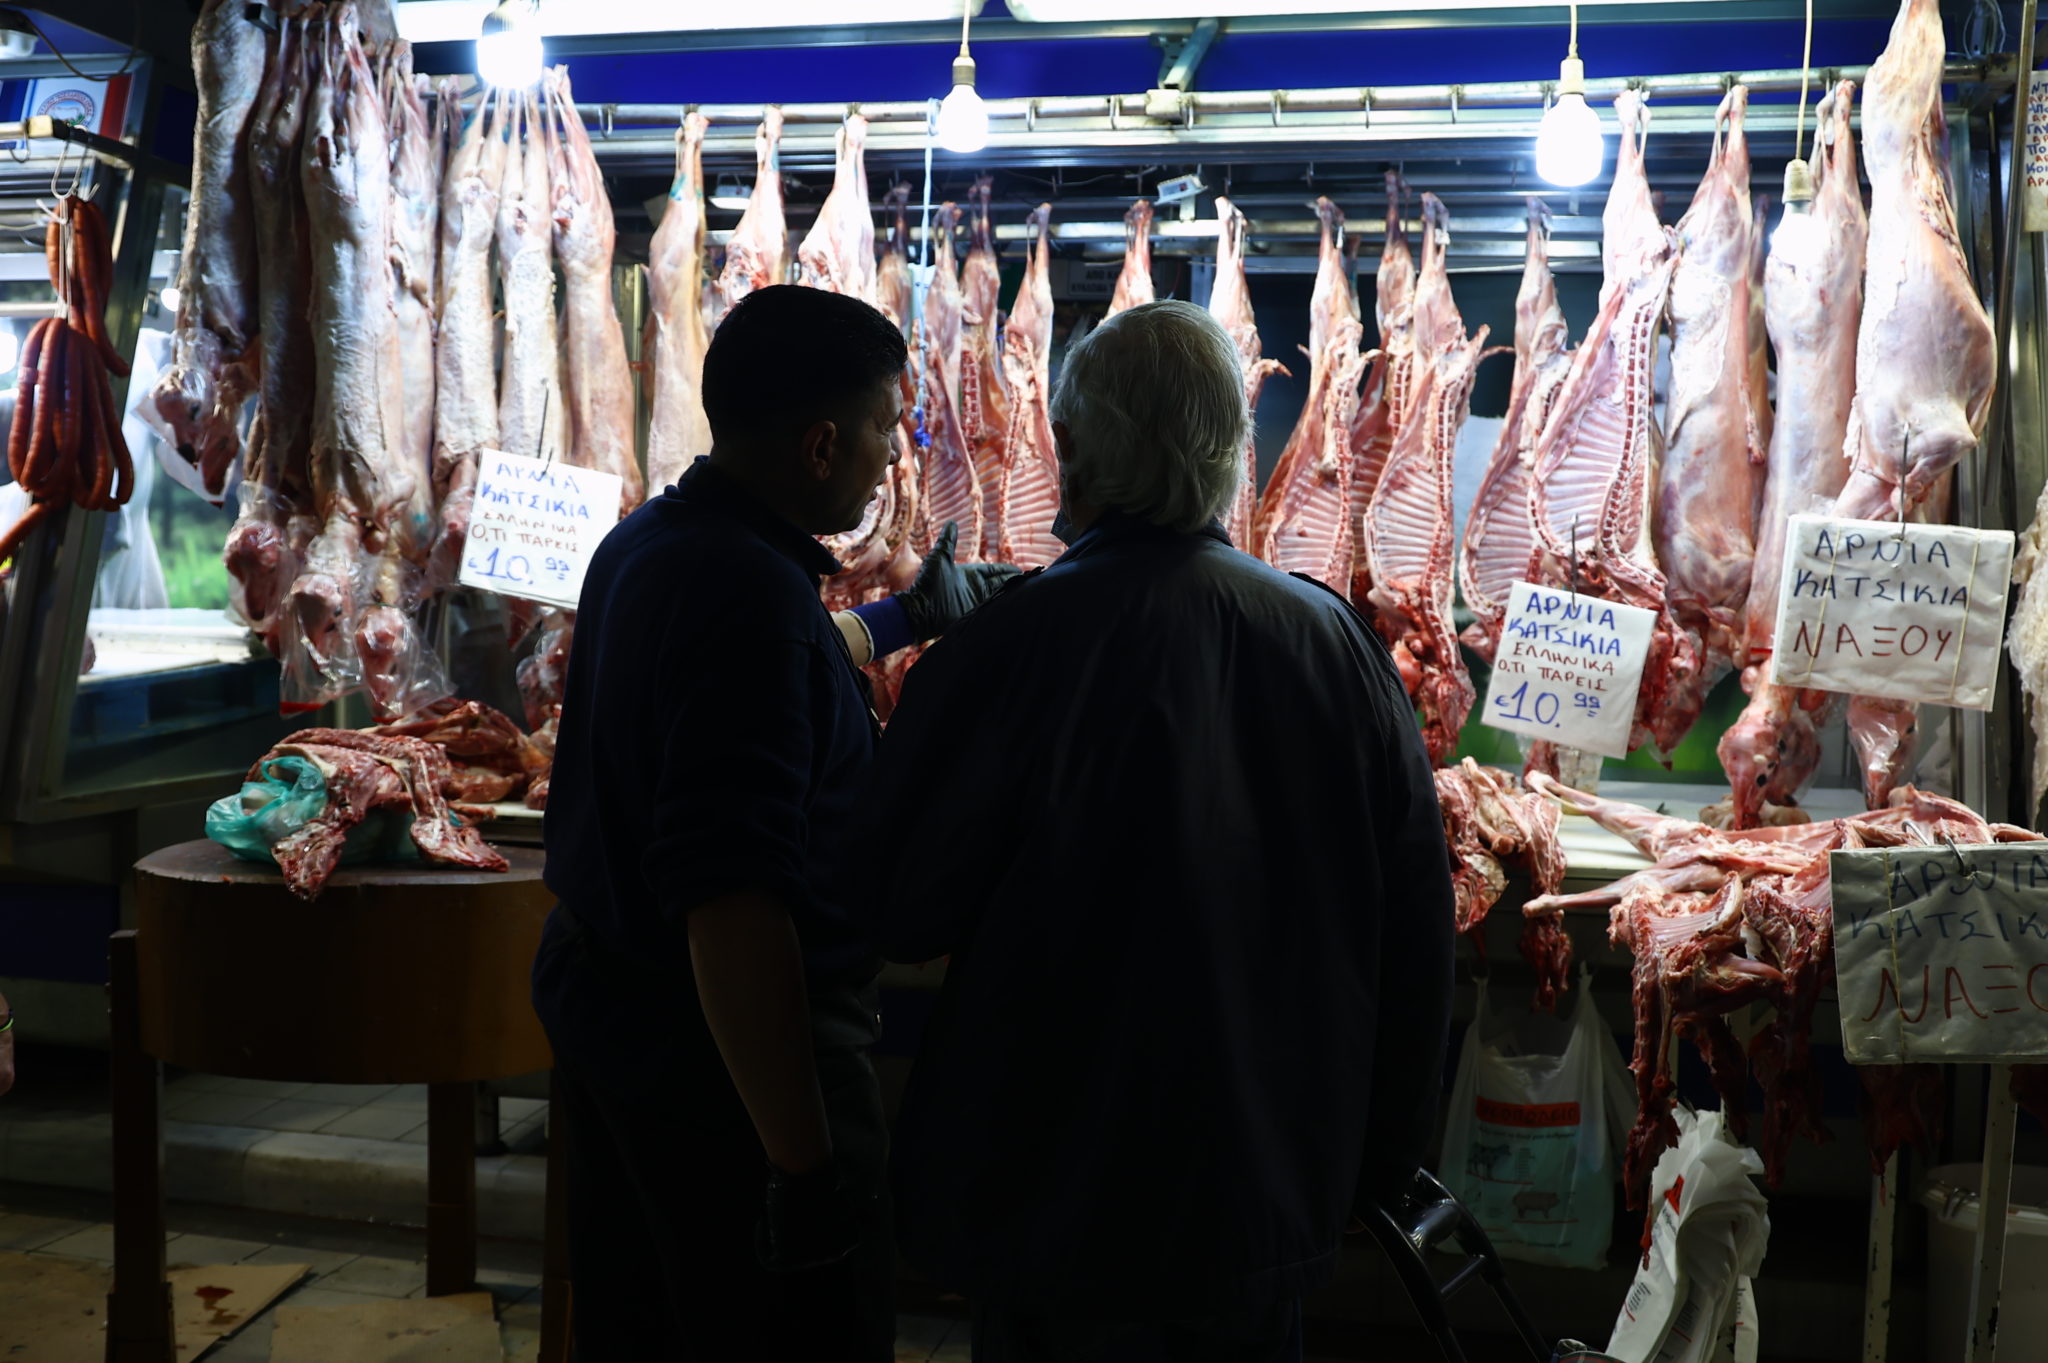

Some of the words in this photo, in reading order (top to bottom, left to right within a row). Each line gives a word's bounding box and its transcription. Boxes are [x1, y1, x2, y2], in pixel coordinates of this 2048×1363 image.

[481, 482, 589, 519] ΚΑΤΣΙΚΙΑ
[1815, 529, 1950, 568] ΑΡΝΙΑ
[1793, 569, 1969, 606] ΚΑΤΣΙΚΙΑ
[1526, 592, 1615, 631] ΑΡΝΙΑ
[1508, 617, 1621, 657] ΚΑΤΣΙΚΙΑ
[1793, 621, 1952, 662] ΝΑΞΟΥ
[1513, 642, 1616, 676] ΕΛΛΗΝΙΚΑ
[1538, 667, 1608, 692] ΠΑΡΕΙΣ
